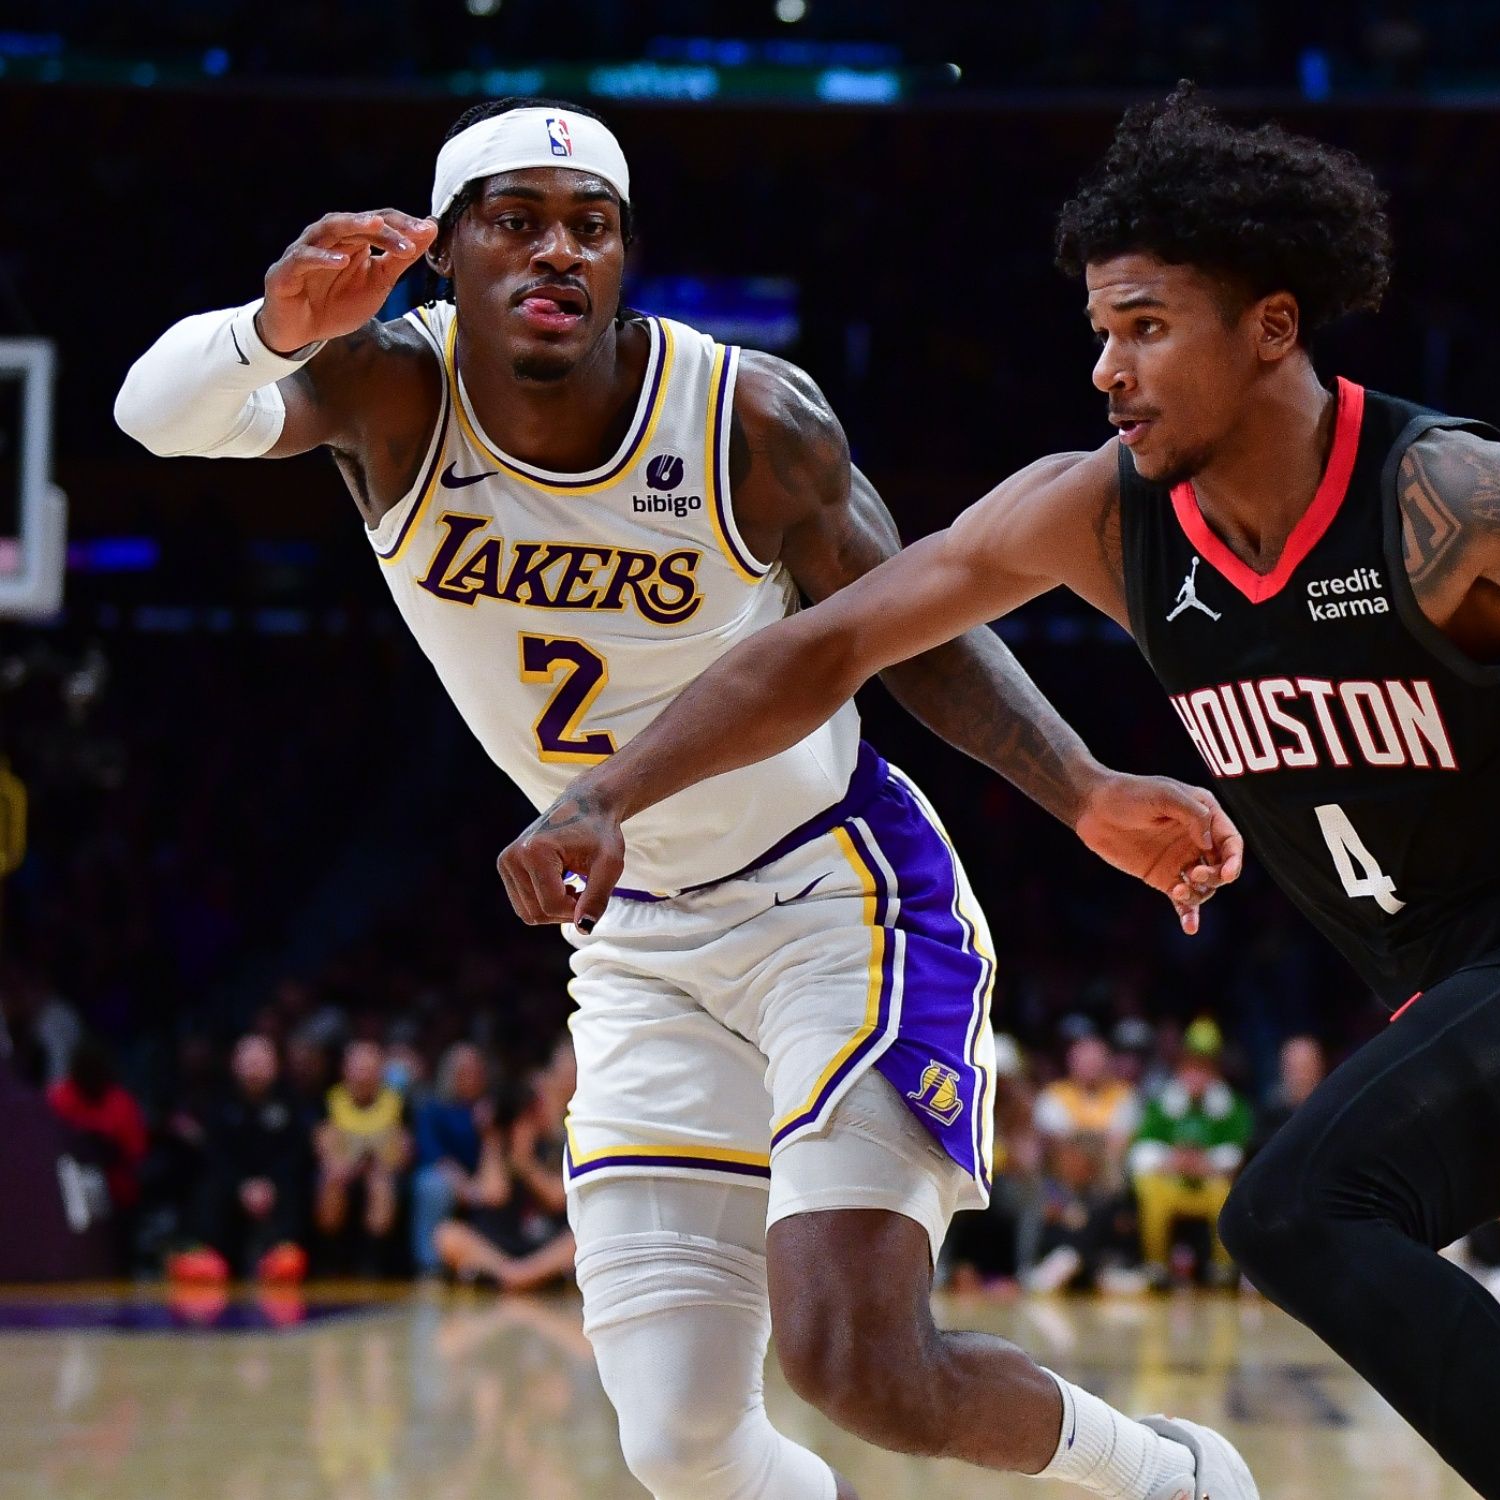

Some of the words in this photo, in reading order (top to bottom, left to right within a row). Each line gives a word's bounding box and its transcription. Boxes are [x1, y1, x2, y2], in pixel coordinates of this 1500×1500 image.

[633, 493, 702, 518] bibigo
[416, 511, 706, 626] LAKERS
[1307, 568, 1382, 597] credit
[1307, 597, 1390, 621] karma
[518, 631, 620, 764] 2
[1168, 676, 1459, 778] HOUSTON
[1314, 803, 1406, 915] 4
